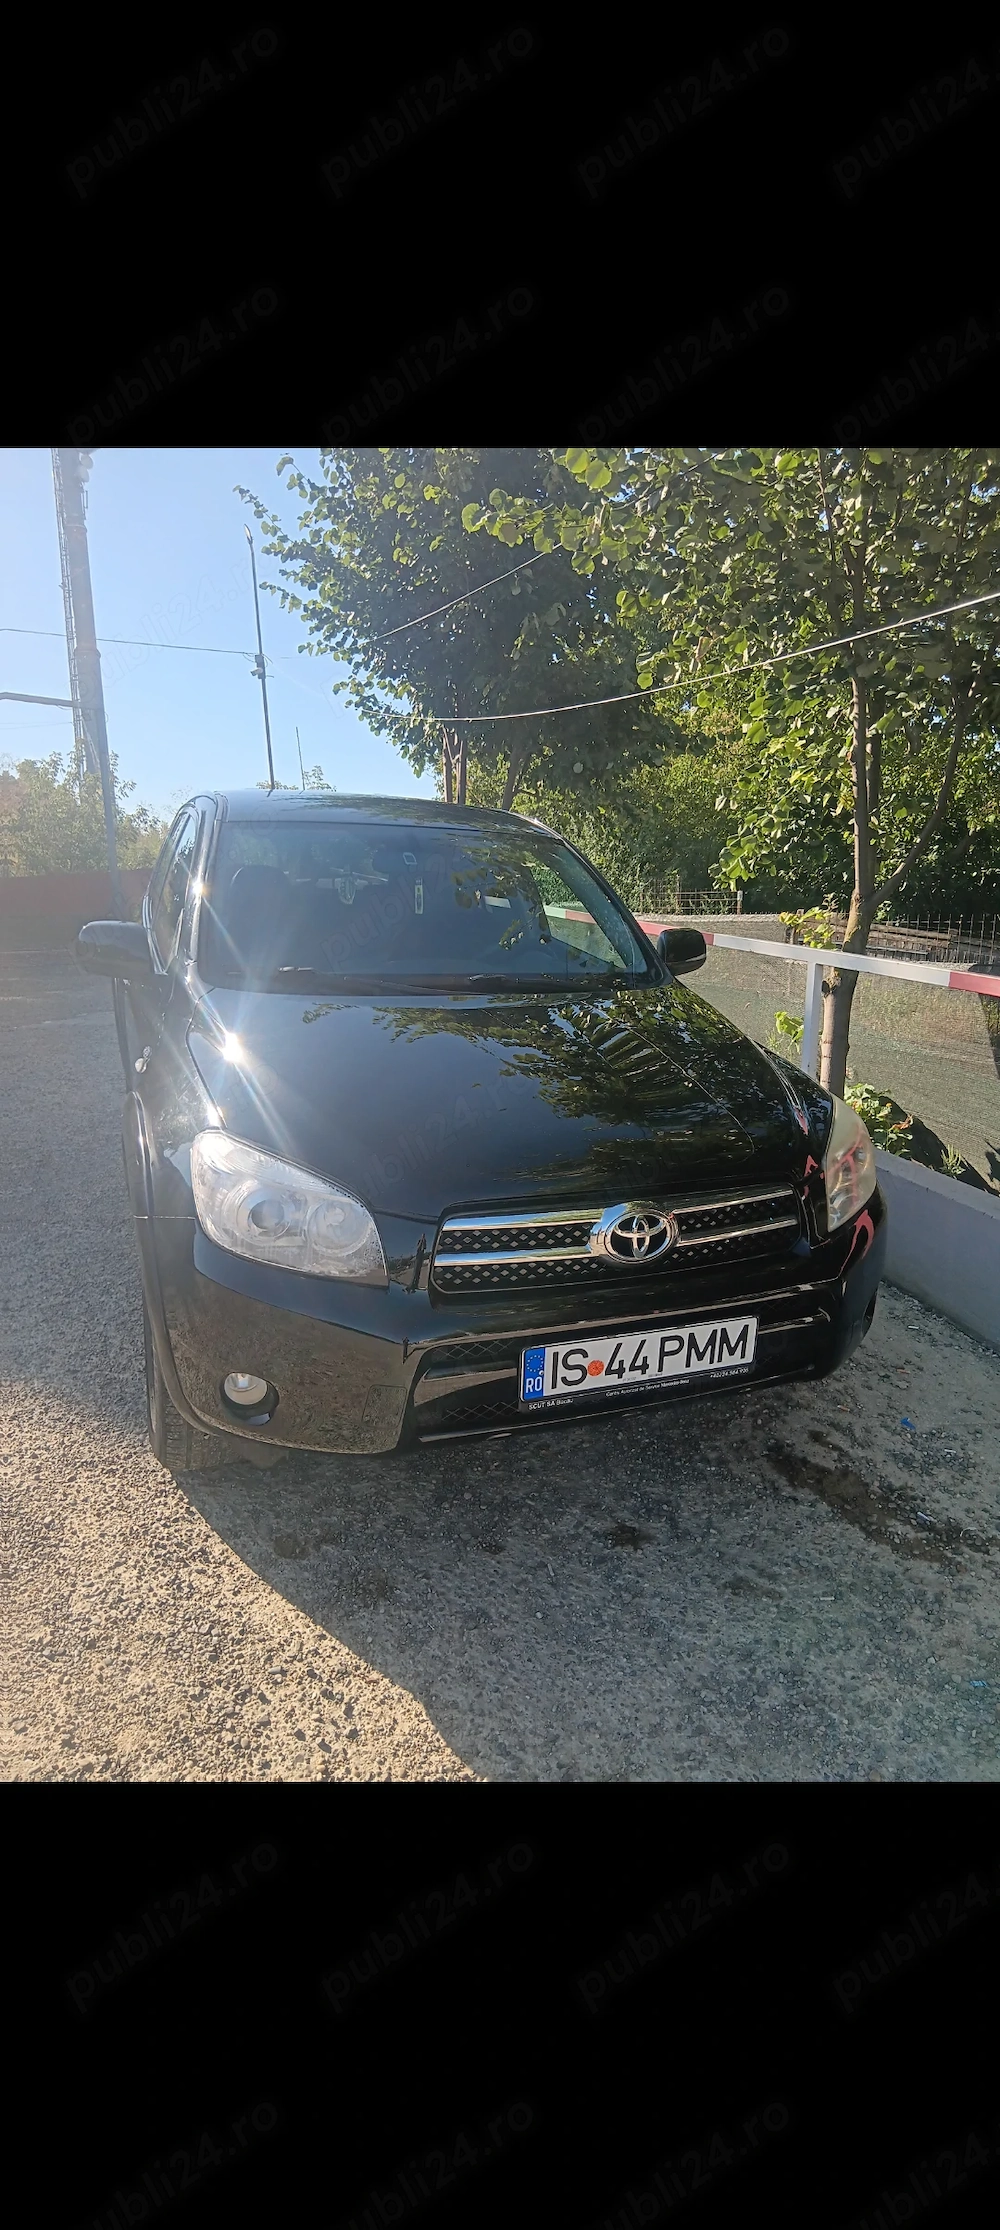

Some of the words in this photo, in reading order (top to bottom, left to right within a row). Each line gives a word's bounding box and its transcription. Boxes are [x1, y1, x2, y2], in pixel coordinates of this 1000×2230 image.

[550, 1348, 589, 1390] IS
[604, 1339, 650, 1379] 44
[657, 1324, 749, 1373] PMM
[525, 1376, 543, 1394] RO
